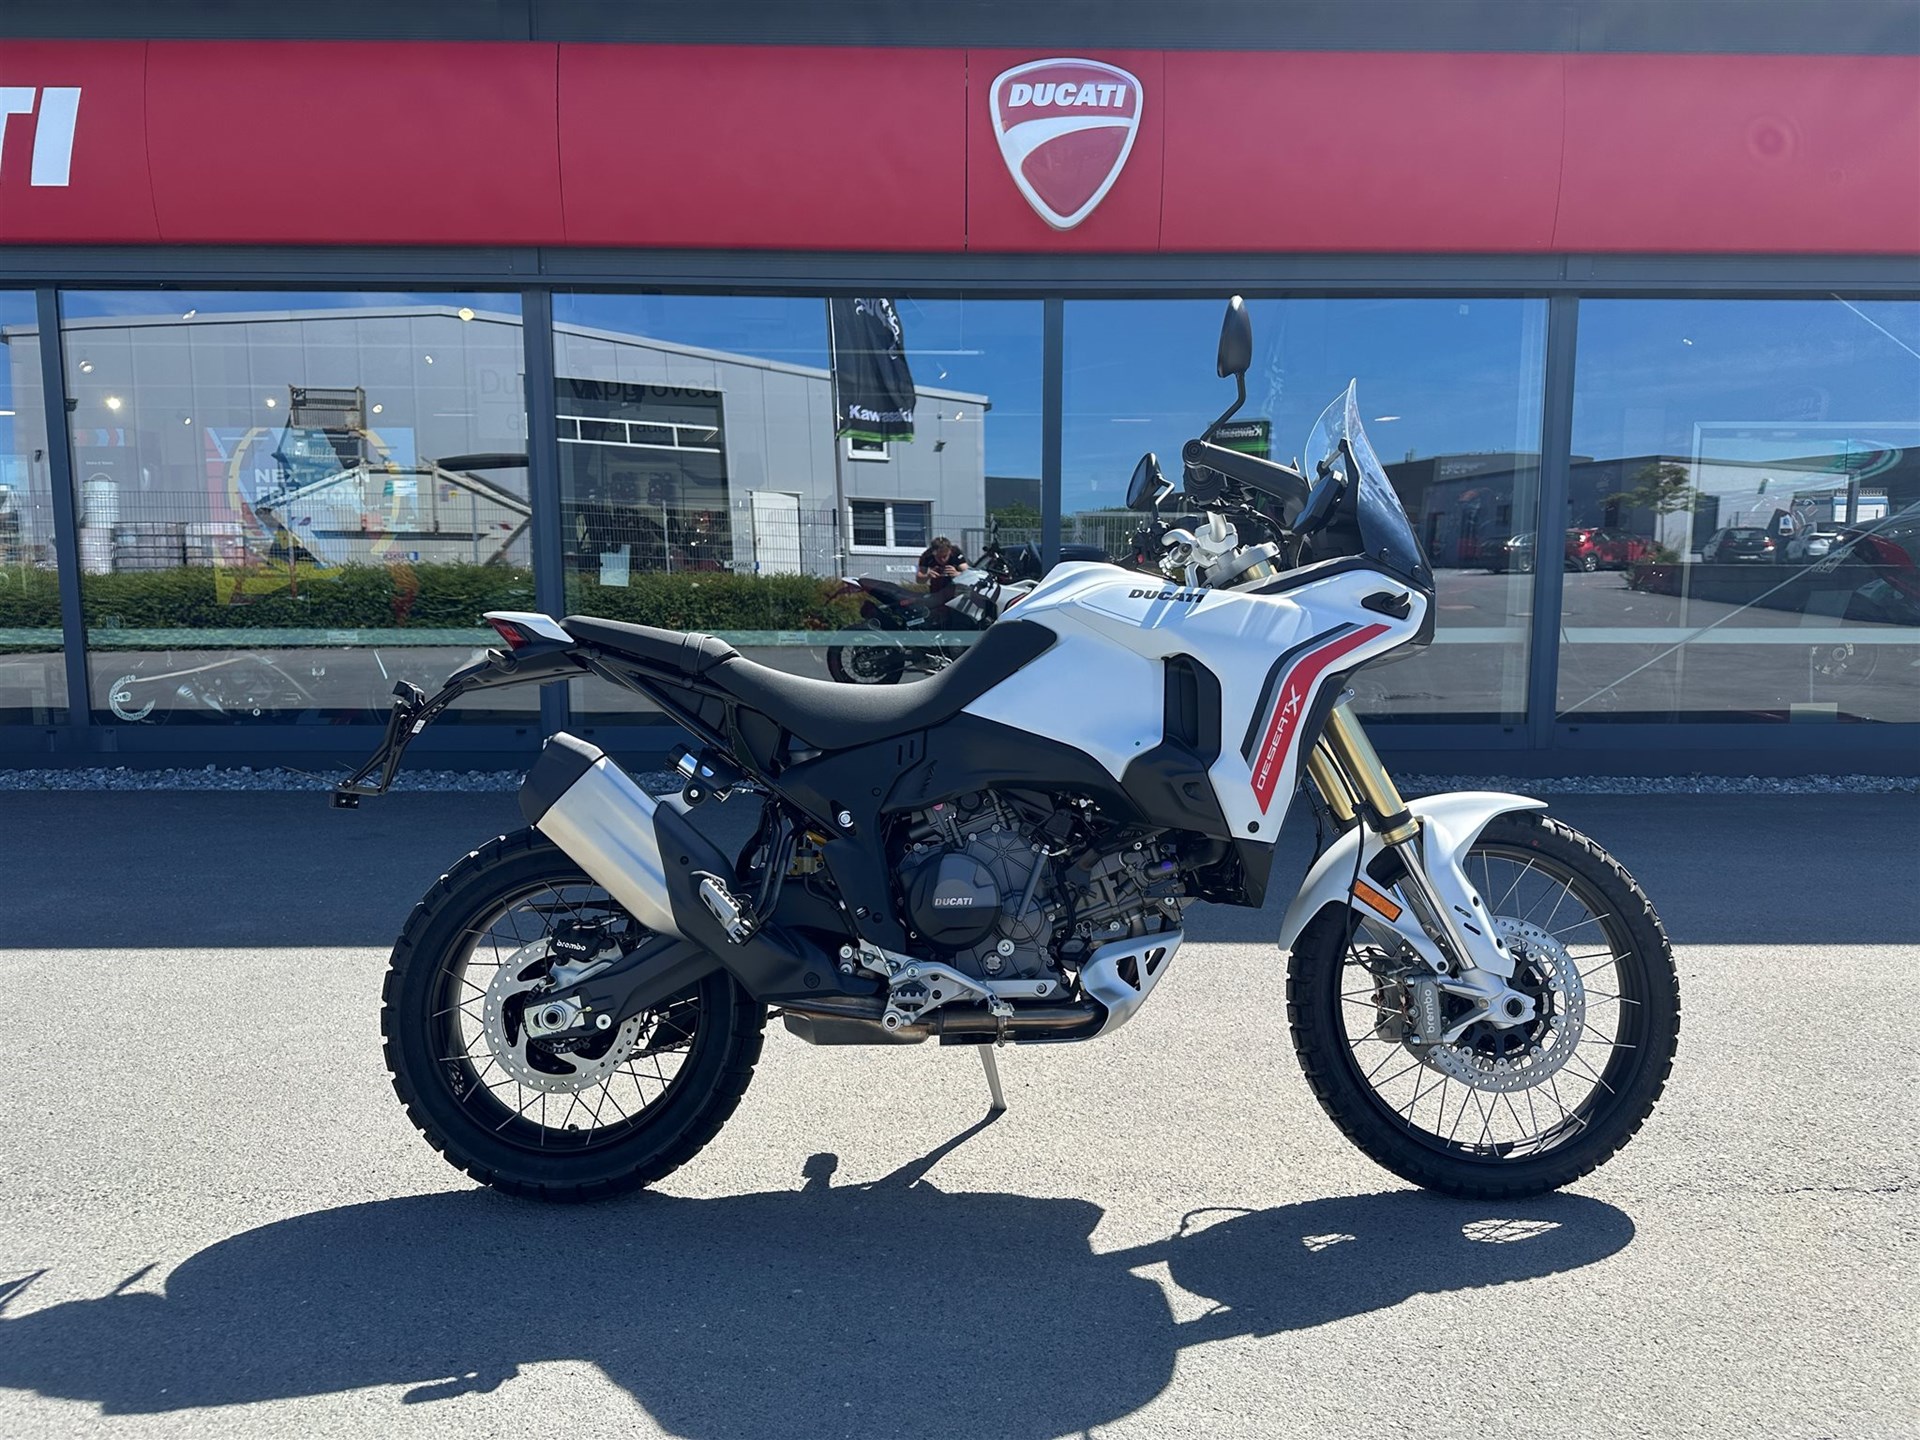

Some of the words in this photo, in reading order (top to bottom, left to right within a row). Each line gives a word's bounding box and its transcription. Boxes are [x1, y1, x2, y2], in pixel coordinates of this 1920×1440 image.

[1008, 83, 1127, 108] DUCATI
[848, 404, 913, 423] Kawasaki
[597, 415, 696, 434] ebrauchte
[254, 468, 370, 483] NEXT-GN
[1128, 589, 1206, 603] DUCATI
[934, 897, 973, 906] DUCATI
[556, 939, 587, 952] brembo
[1423, 989, 1435, 1034] brembo
